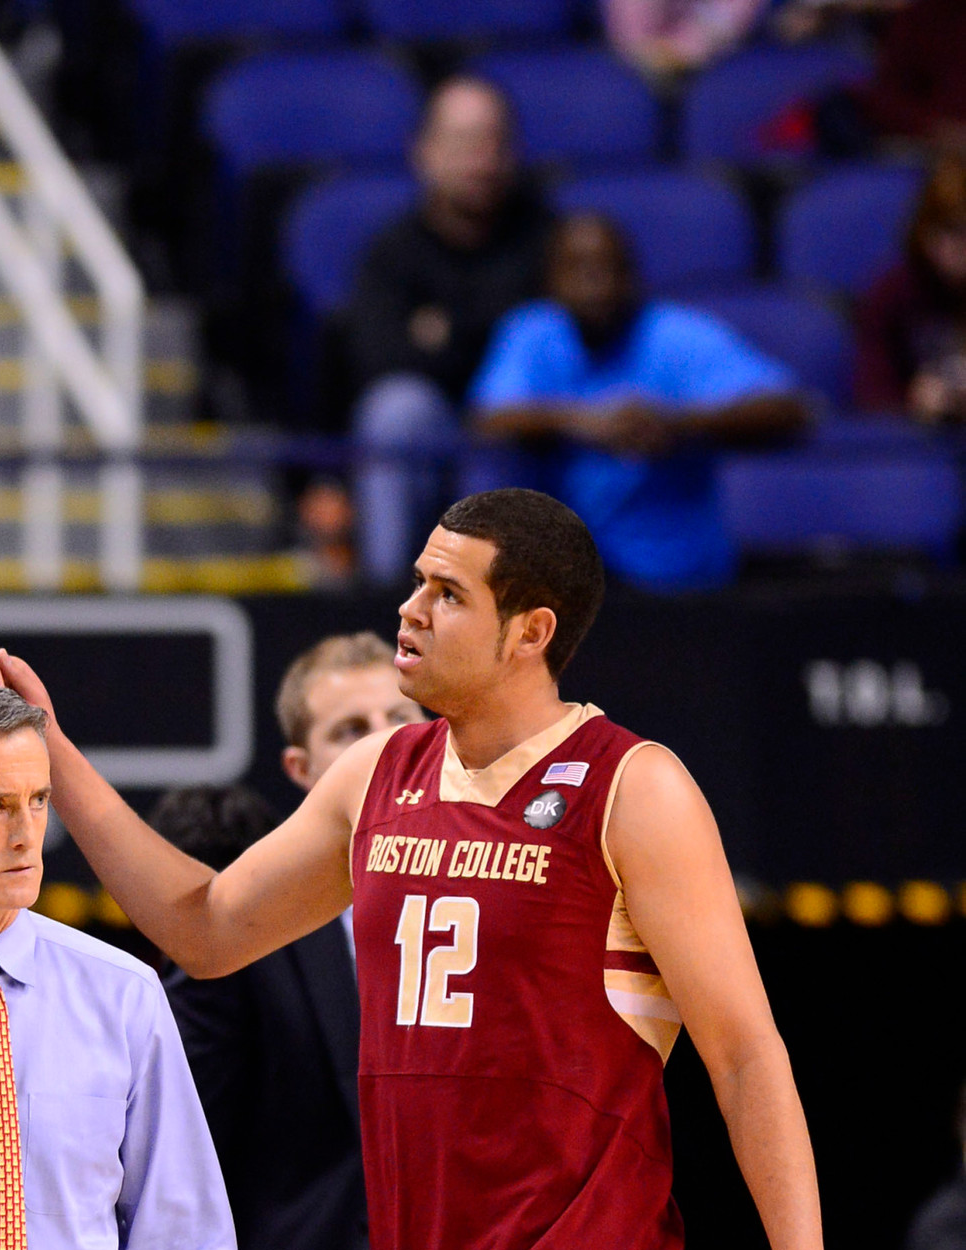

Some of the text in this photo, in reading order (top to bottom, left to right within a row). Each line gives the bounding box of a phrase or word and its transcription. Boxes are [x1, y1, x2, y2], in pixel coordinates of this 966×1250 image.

[530, 800, 560, 816] DK
[366, 834, 552, 884] BOSTON COLLEGE
[394, 894, 480, 1028] 12
